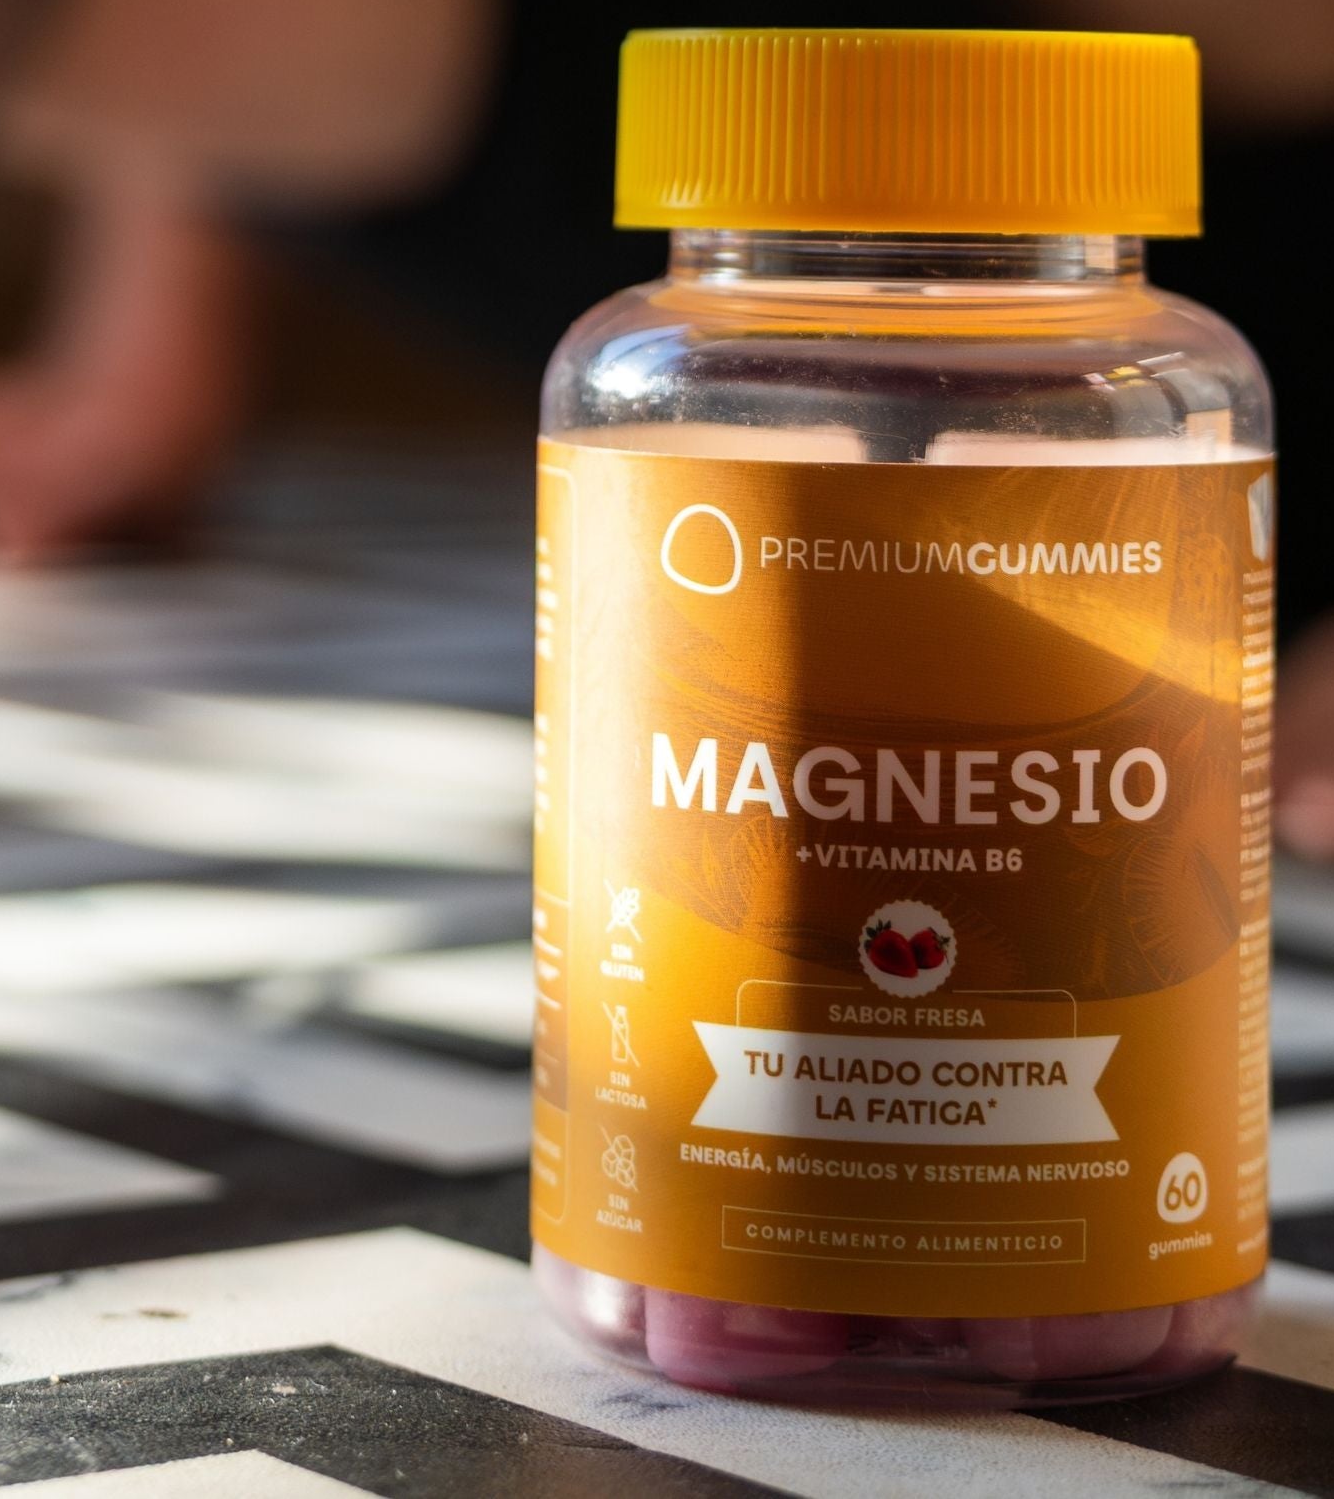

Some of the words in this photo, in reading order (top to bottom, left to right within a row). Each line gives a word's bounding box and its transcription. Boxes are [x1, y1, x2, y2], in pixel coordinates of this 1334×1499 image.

[758, 536, 1163, 576] PREMIUMGUMMIES
[651, 732, 1168, 825] MAGNESIO
[795, 844, 977, 872] +VITAMINA
[985, 848, 1023, 872] B6
[610, 942, 634, 961] SIN
[600, 959, 645, 982] GLUTEN
[828, 1004, 908, 1026] SABOR
[914, 1007, 986, 1027] FRESA
[609, 1070, 631, 1088] SIN
[744, 1050, 784, 1077] TU
[794, 1055, 921, 1086] ALIADO
[931, 1060, 1068, 1087] CONTRA
[595, 1084, 647, 1110] LACTOSA
[816, 1095, 855, 1122] LA
[680, 1143, 772, 1174] ENERGÍA,
[776, 1154, 897, 1181] MÚSCULOS
[904, 1164, 918, 1182] Y
[924, 1164, 1021, 1183] SISTEMA
[1027, 1159, 1131, 1182] NERVIOSO
[608, 1193, 629, 1212] SIN
[1163, 1170, 1202, 1211] 60
[746, 1223, 906, 1250] COMPLEMENTO
[916, 1234, 1063, 1252] ALIMENTICIO
[1148, 1230, 1213, 1260] gummies
